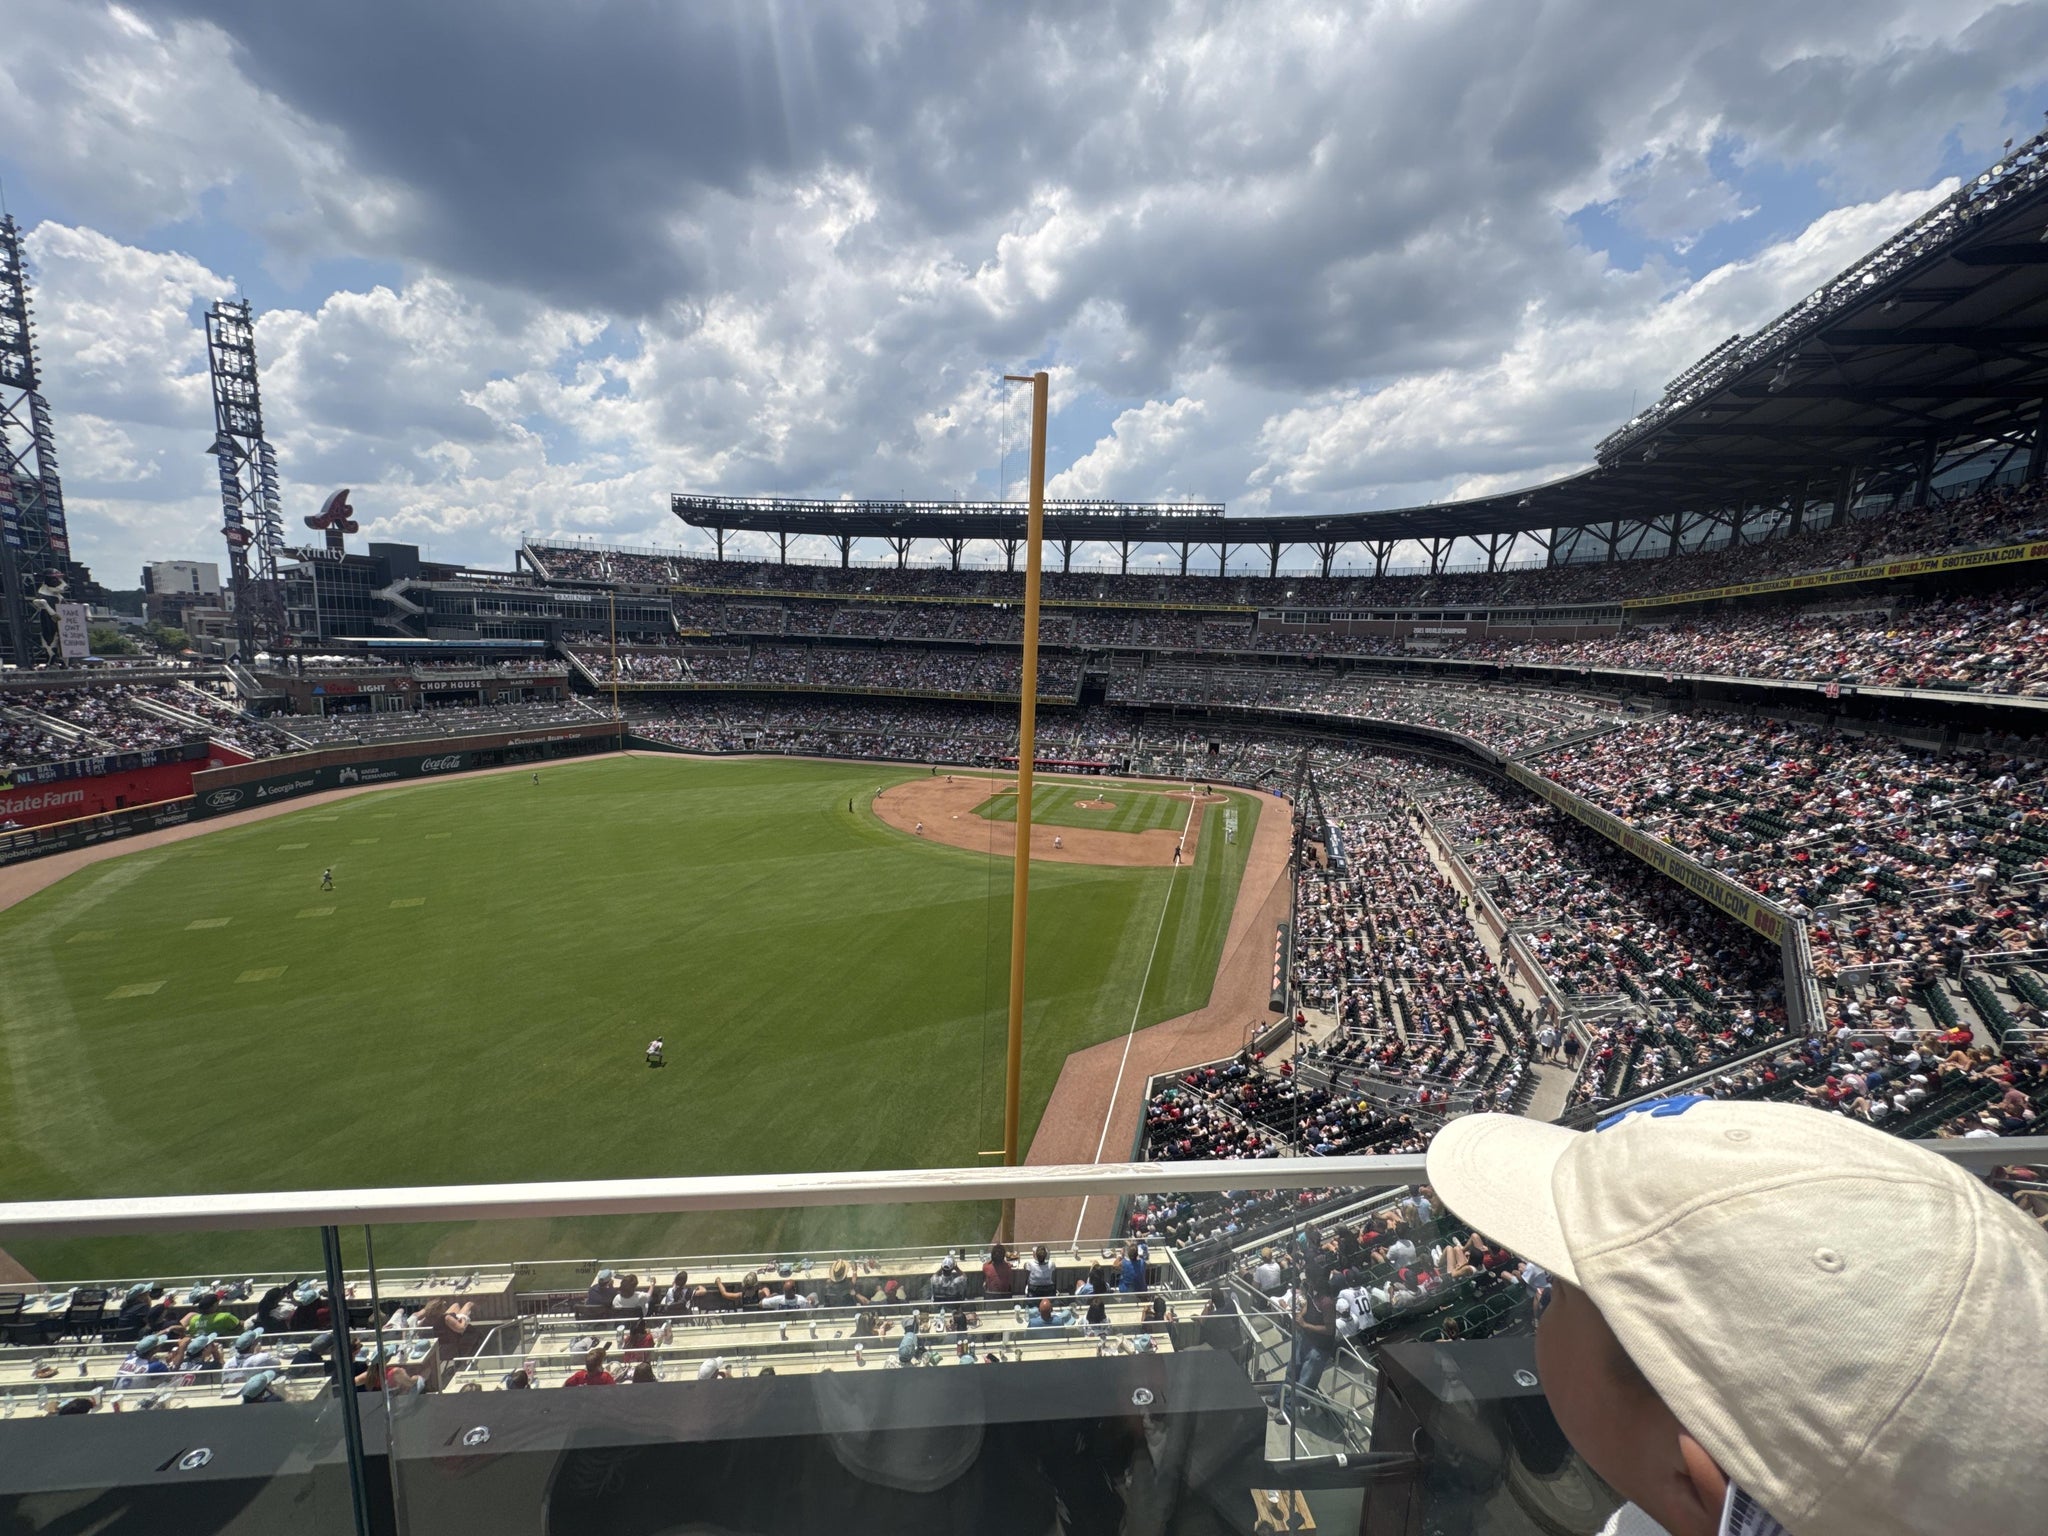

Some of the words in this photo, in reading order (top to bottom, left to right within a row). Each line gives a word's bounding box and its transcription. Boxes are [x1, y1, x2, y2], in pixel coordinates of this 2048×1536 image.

[296, 543, 346, 563] xfinity
[1830, 566, 1885, 582] 680THEFAN.COM
[1942, 547, 2025, 569] 680THEFAN.COM
[358, 684, 386, 693] LIGHT
[420, 681, 447, 690] CHOP
[450, 680, 482, 689] HOUSE
[1824, 681, 1839, 698] 44
[421, 755, 461, 772] Coca-Cola
[17, 773, 35, 783] NL
[268, 782, 294, 795] Georgia
[295, 778, 314, 789] Power
[43, 790, 85, 808] Farm
[212, 791, 236, 804] Ford
[1669, 859, 1750, 920] 680THEFAN.COM
[1355, 1297, 1371, 1316] 10
